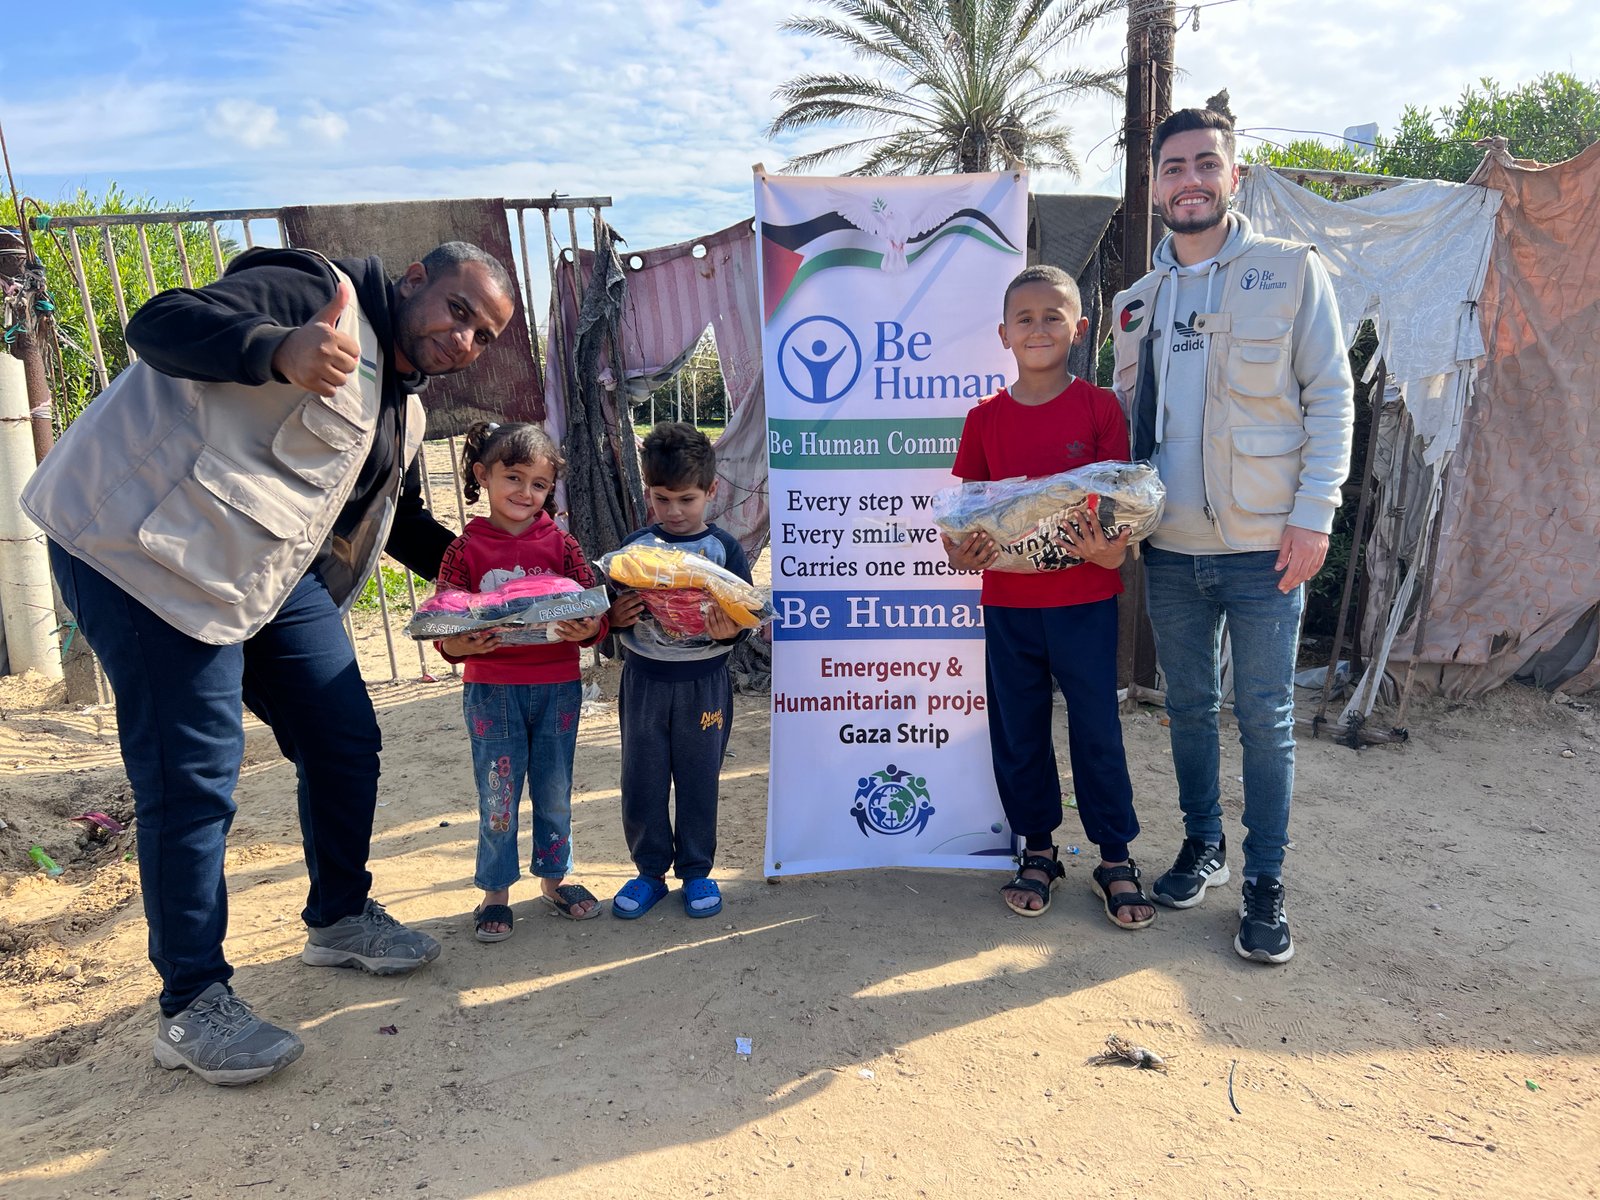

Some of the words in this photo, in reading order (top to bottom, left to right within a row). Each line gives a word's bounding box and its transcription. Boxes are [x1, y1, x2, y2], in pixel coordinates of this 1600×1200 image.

[1259, 281, 1287, 290] Human
[1261, 270, 1275, 281] Be
[874, 321, 932, 362] Be
[874, 367, 1005, 400] Human
[769, 430, 793, 456] Be
[799, 431, 881, 456] Human
[887, 430, 961, 456] Comm
[787, 489, 852, 516] Every
[858, 492, 903, 516] step
[781, 522, 845, 549] Every
[852, 522, 905, 544] smile
[905, 527, 937, 544] we
[780, 555, 858, 577] Carries
[865, 560, 906, 576] one
[539, 598, 591, 621] FASHION
[780, 597, 831, 629] Be
[821, 657, 941, 683] Emergency
[946, 656, 963, 677] &
[774, 690, 917, 714] Humanitarian
[928, 689, 985, 716] proje
[839, 723, 892, 745] Gaza
[897, 722, 950, 749] Strip
